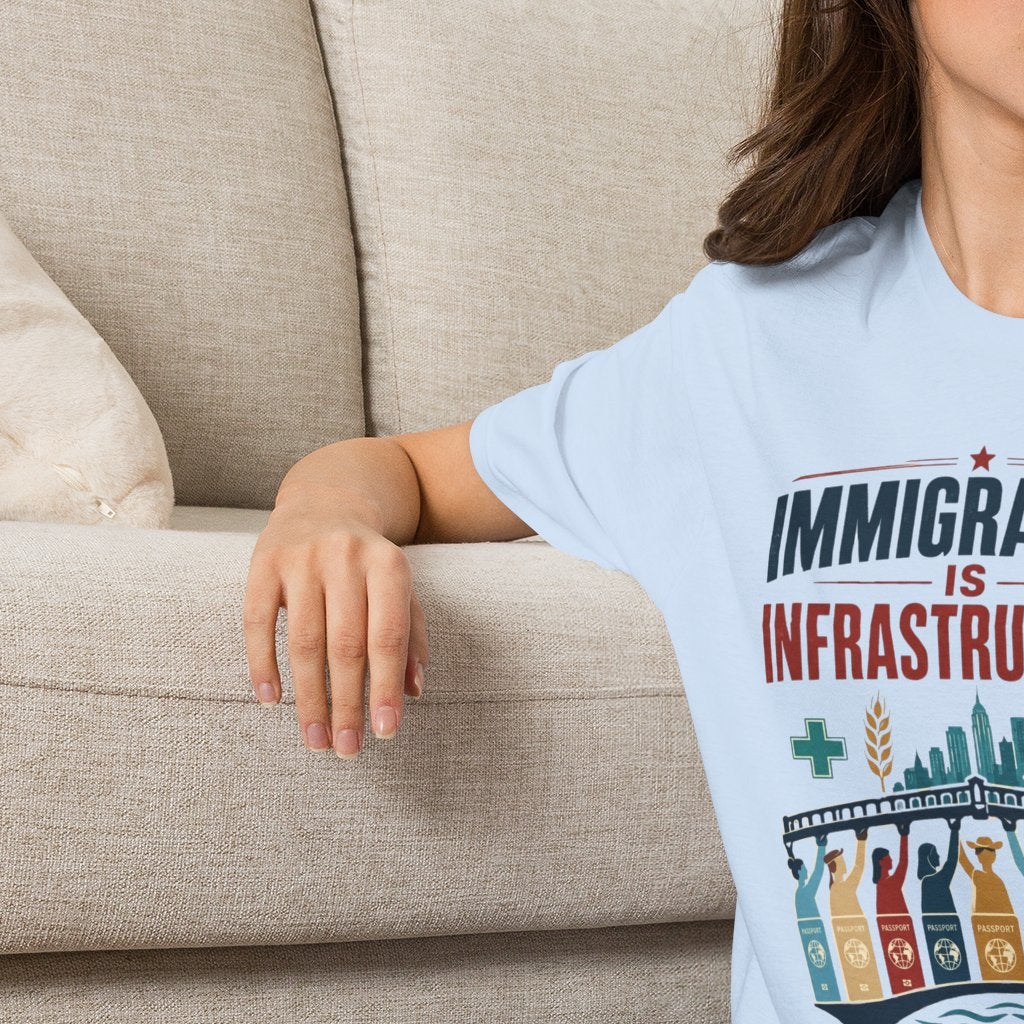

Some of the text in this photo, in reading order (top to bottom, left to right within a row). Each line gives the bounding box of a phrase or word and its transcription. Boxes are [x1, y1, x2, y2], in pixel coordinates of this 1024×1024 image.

[945, 564, 986, 597] IS
[836, 925, 865, 933] PASSPORT
[881, 923, 910, 932] PASSPORT
[927, 924, 958, 932] PASSPORT
[977, 924, 1015, 933] PASSPORT
